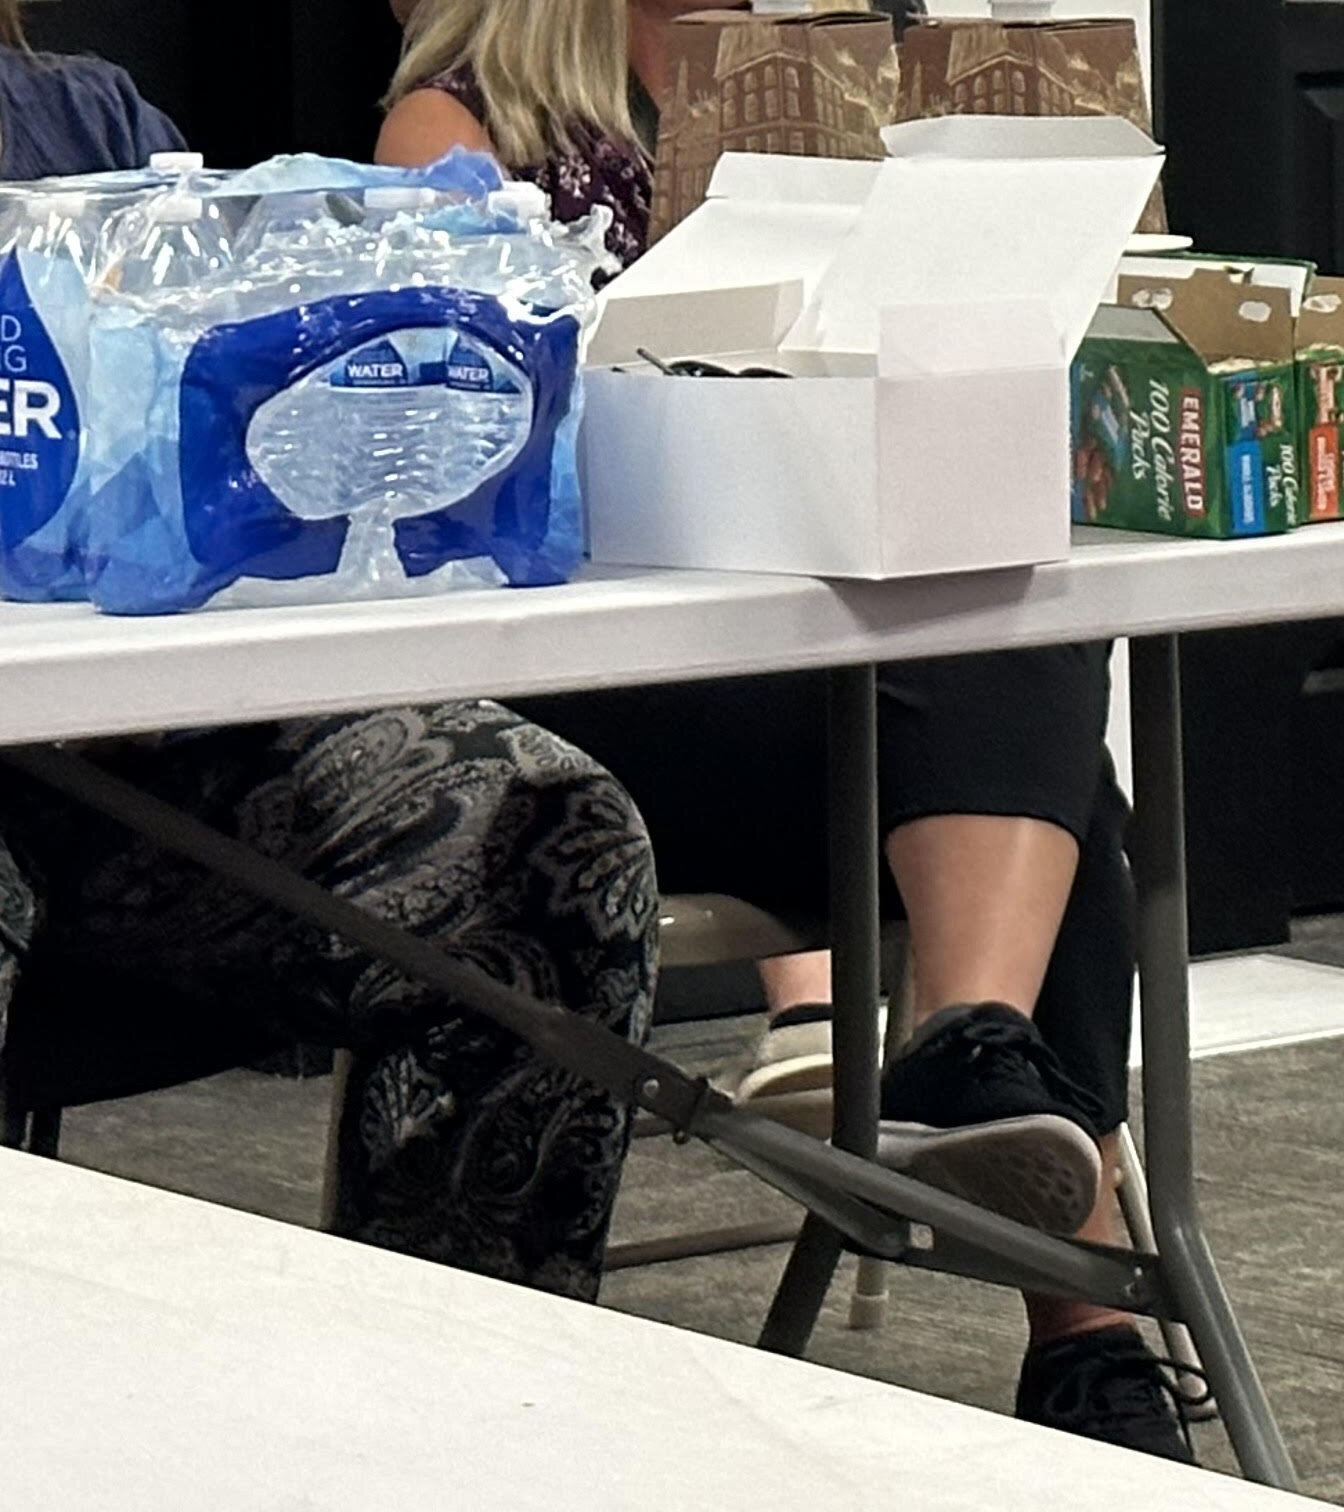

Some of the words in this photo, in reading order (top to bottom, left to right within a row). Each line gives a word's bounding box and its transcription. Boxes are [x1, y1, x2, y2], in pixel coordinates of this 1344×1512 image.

[347, 363, 403, 377] WATER
[1150, 379, 1170, 433] 100
[1129, 410, 1151, 480] Packs
[1151, 436, 1175, 522] Calorie
[1180, 396, 1204, 510] EMERALD
